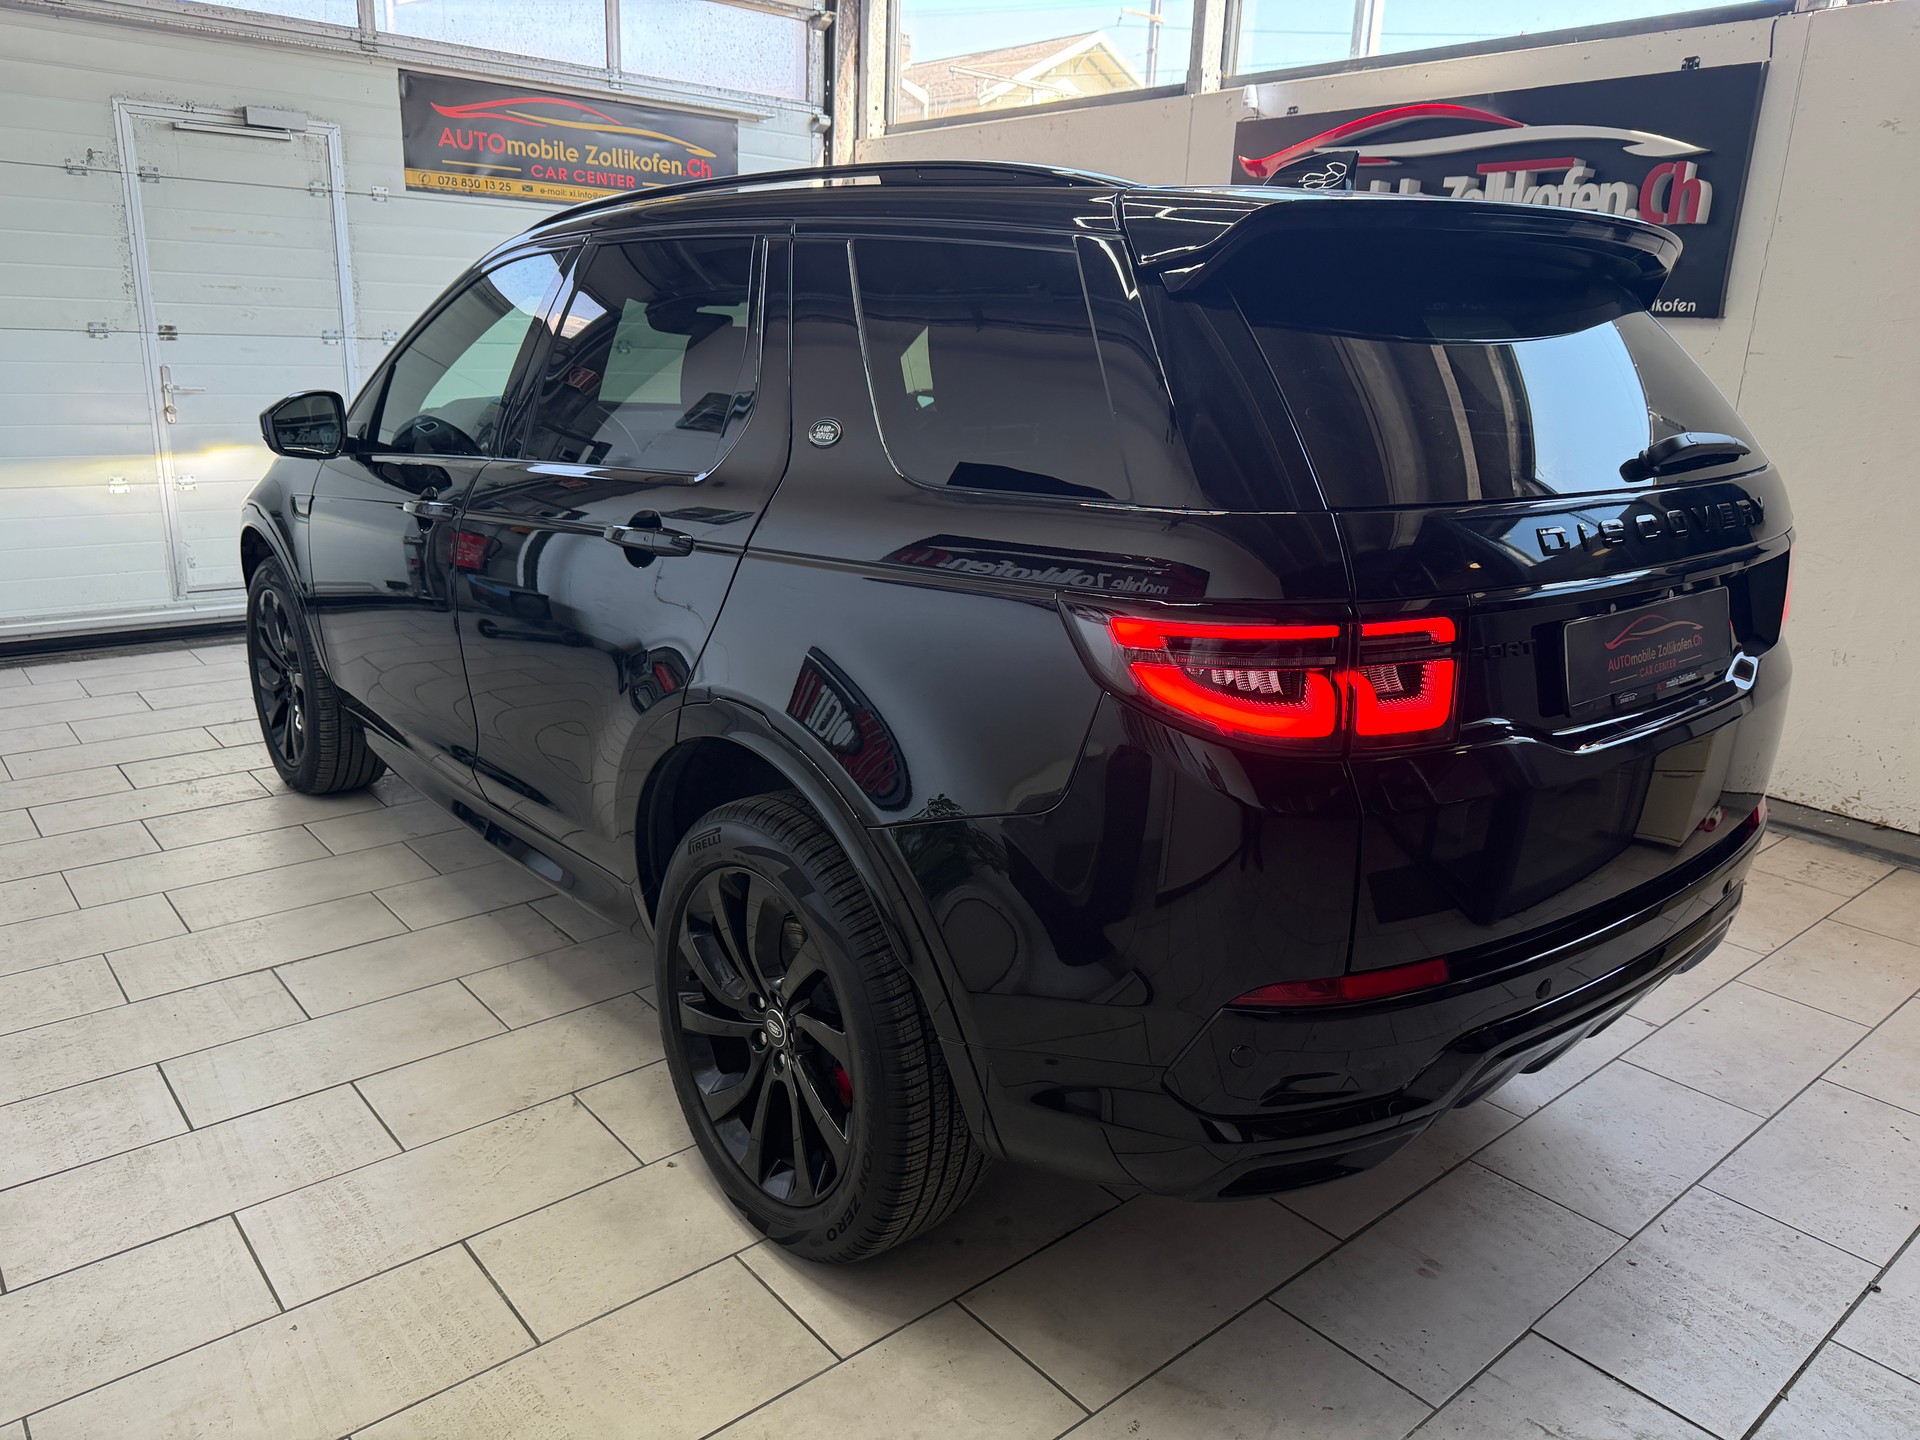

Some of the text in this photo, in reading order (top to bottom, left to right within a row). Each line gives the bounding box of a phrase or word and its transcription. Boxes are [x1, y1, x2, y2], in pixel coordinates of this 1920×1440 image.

[438, 127, 712, 179] AUTOmobile Zollikofen.Ch
[438, 176, 511, 192] 078 830 13 25
[531, 164, 635, 188] CAR CENTER
[540, 188, 567, 197] e-mail:
[1536, 496, 1765, 557] DISCOVERY
[1608, 633, 1703, 672] AUTOmobile Zollikofen.Ch
[1640, 659, 1677, 678] CAR CENTER
[688, 827, 722, 855] PIRELLI
[827, 1192, 861, 1242] ZERO
